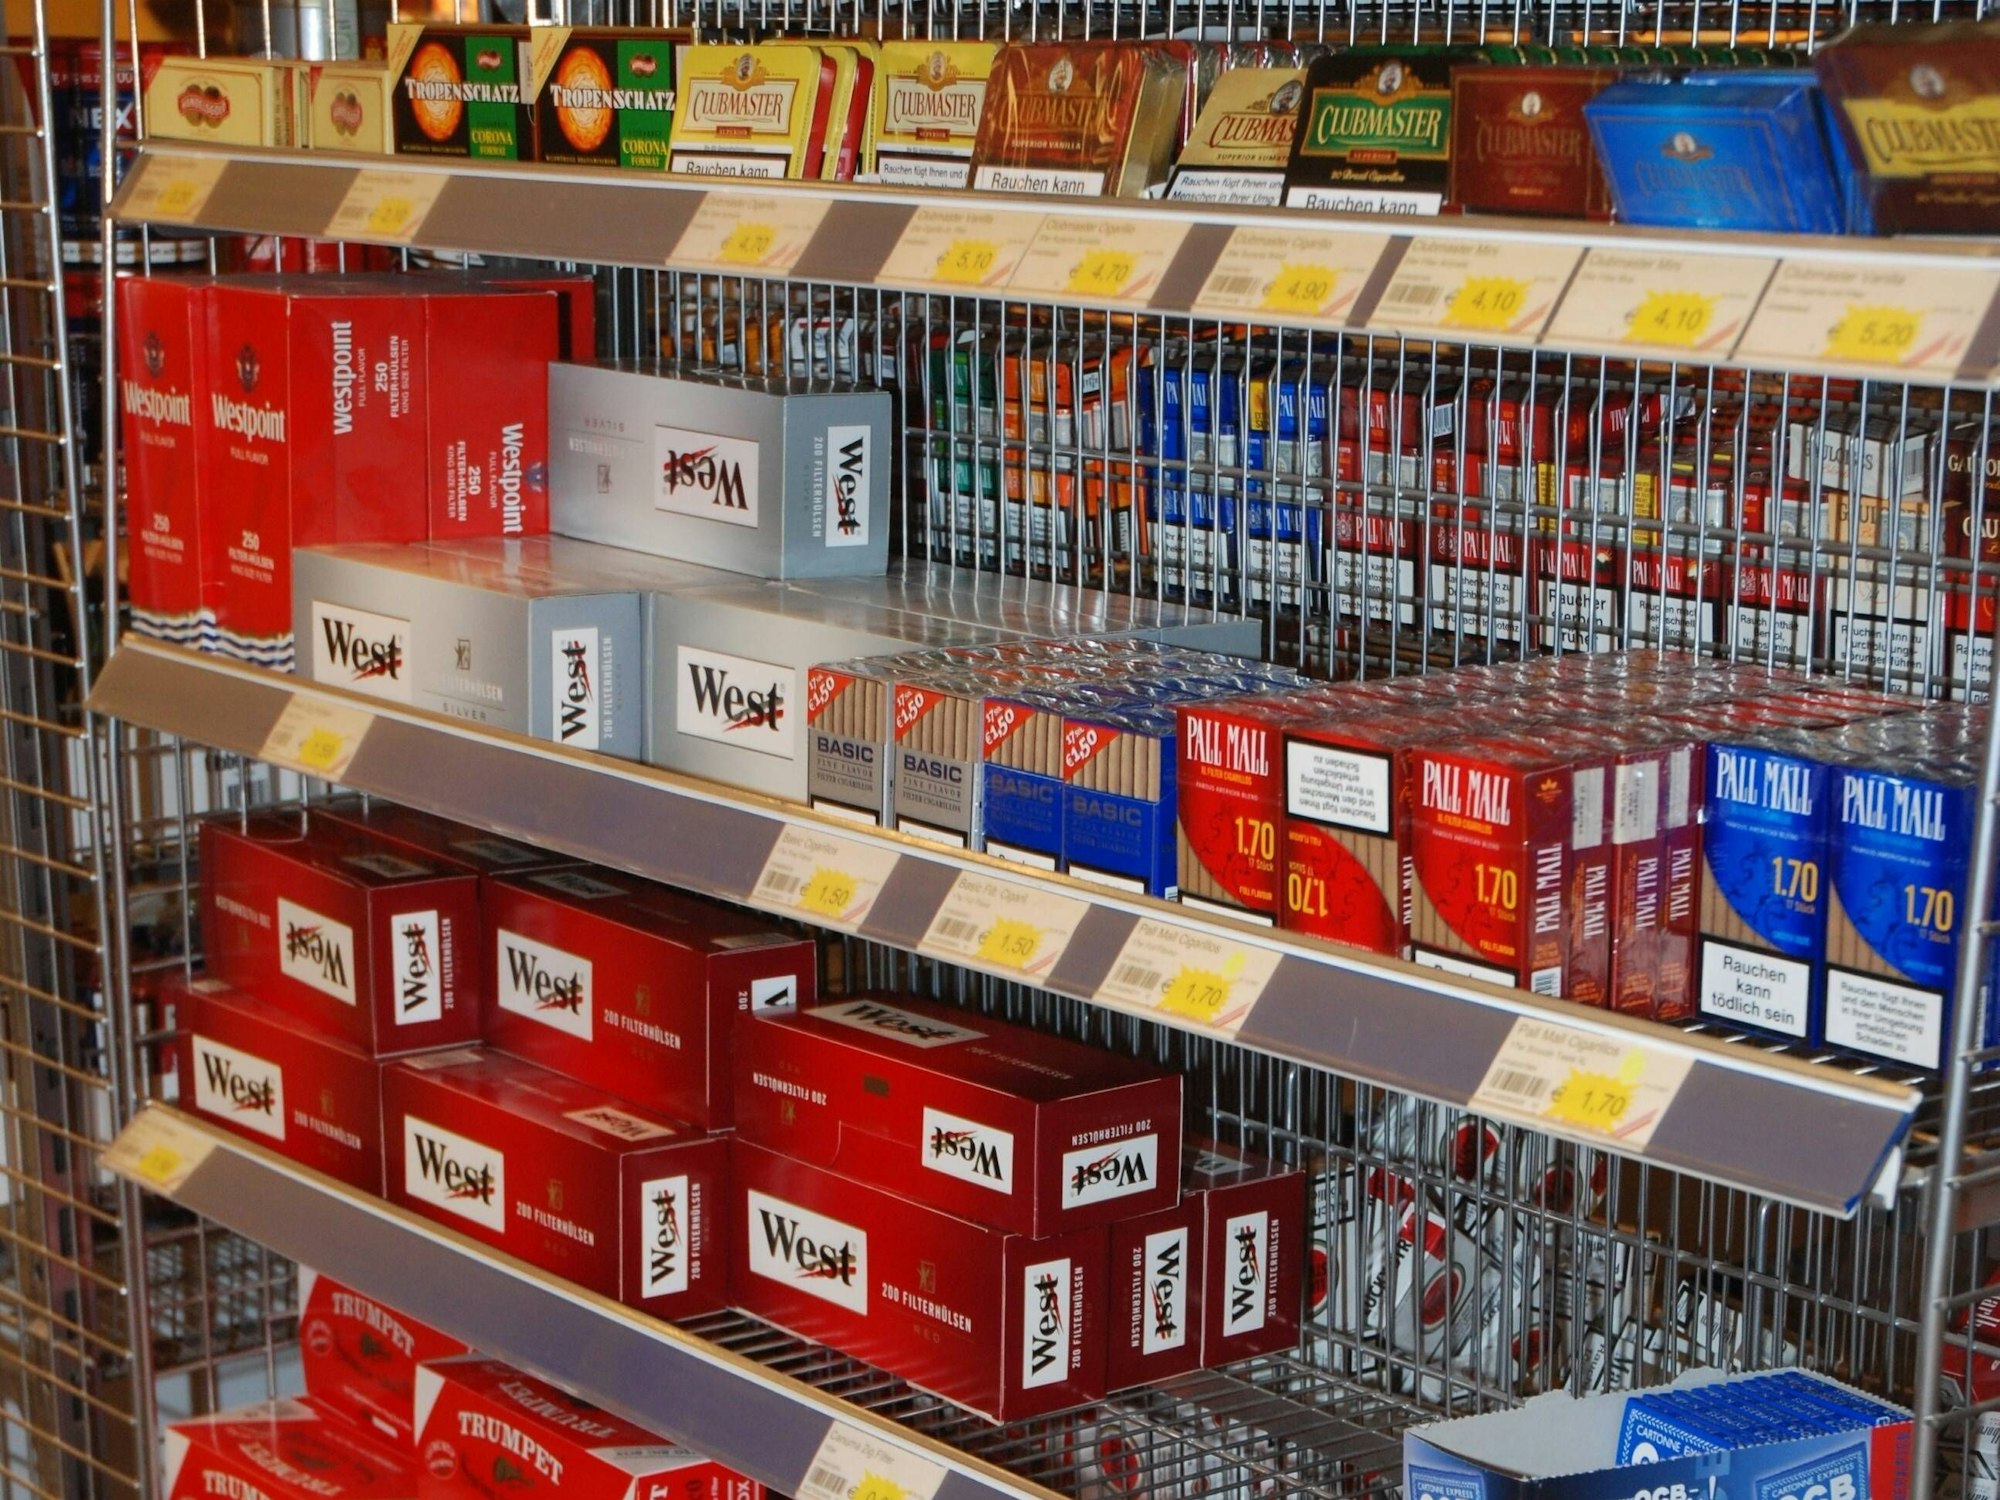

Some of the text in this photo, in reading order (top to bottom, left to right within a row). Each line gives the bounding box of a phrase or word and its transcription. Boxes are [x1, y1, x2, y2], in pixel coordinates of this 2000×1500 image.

[405, 78, 519, 104] TROPENSCHATZ
[551, 84, 676, 111] TROPENSCHATZ
[693, 89, 784, 122] CLUBMASTER
[893, 89, 976, 125] CLUBMASTER
[472, 130, 513, 145] CORONA
[622, 139, 669, 155] CORONA
[1011, 139, 1081, 150] SUPERIOR VANILLA
[1317, 105, 1442, 147] CLUBMASTER
[631, 156, 659, 167] FORMAT
[687, 161, 768, 178] Rauchen kann
[885, 163, 962, 179] Rauchen fügt Ihnen und
[991, 172, 1085, 194] Rauchen kann
[1181, 177, 1266, 187] Rauchen Ihnen
[1306, 194, 1417, 215] Rauchen kann
[1092, 263, 1129, 281] 4,70
[1287, 282, 1328, 301] 4,90
[1472, 291, 1516, 313] 4,10
[1654, 308, 1704, 330] 4,10
[1860, 320, 1914, 346] 5,20
[331, 320, 356, 435] Westpoint
[358, 348, 366, 407] FULL FLAVOR
[375, 363, 388, 392] 250
[124, 381, 191, 427] Westpoint
[212, 393, 285, 442] Westpoint
[468, 466, 481, 495] 250
[498, 423, 527, 533] Westpoint
[665, 447, 749, 511] West
[813, 436, 823, 538] 200 FILTERHÜLSEN
[832, 435, 865, 537] West
[242, 530, 260, 551] 250
[321, 617, 402, 681] West
[561, 640, 594, 741] West
[603, 637, 613, 739] 200 FILTERHÜLSEN
[688, 663, 784, 732] West
[443, 702, 487, 722] SILVER
[817, 736, 873, 763] BASIC
[1186, 715, 1268, 776] PALL MALL
[817, 759, 873, 779] FINE FLAVOR
[904, 754, 962, 783] BASIC
[991, 774, 1053, 803] BASIC
[1716, 751, 1812, 816] PALL MALL
[929, 783, 961, 798] FLAVOR
[1073, 795, 1142, 827] BASIC
[1422, 760, 1510, 825] PALL MALL
[1842, 775, 1945, 842] PALL MALL
[1235, 816, 1275, 860] 1.70
[1256, 859, 1274, 871] Stück
[1475, 863, 1517, 909] 1.70
[1536, 842, 1563, 889] MALL
[1670, 848, 1692, 921] PALL MALL
[1772, 855, 1819, 903] 1.70
[818, 885, 850, 907] 1,50
[1288, 873, 1328, 917] 1.70
[1535, 890, 1561, 934] PALL
[1583, 865, 1607, 939] PALL MALL
[1635, 857, 1658, 930] PALL MALL
[1904, 884, 1954, 932] 1.70
[286, 922, 348, 989] West
[1001, 934, 1035, 956] 1,50
[402, 922, 432, 1014] West
[507, 946, 583, 1016] West
[1723, 955, 1787, 984] Rauchen
[738, 990, 748, 1011] 200
[1187, 983, 1223, 1007] 1,70
[1712, 992, 1795, 1026] tödlich sein
[1736, 980, 1772, 1000] kann
[604, 1008, 681, 1049] 200 FILTERHÜLSEN
[843, 1002, 958, 1040] West
[203, 1051, 274, 1116] West
[753, 1072, 827, 1106] FILTERHÜLSEN 200
[1582, 1090, 1626, 1117] 1,70
[931, 1126, 1004, 1181] West
[1071, 1118, 1152, 1146] FILTERHÜLSEN 200
[414, 1133, 494, 1206] West
[1071, 1150, 1149, 1203] West
[516, 1200, 595, 1247] 200 FILTERHÜLSEN
[651, 1189, 682, 1286] West
[691, 1182, 701, 1280] 200 FILTERHÜLSEN
[758, 1208, 857, 1287] West
[1268, 1219, 1279, 1317] 200 FILTERHÜLSEN
[1151, 1239, 1181, 1340] West
[1231, 1224, 1261, 1325] West
[882, 1282, 972, 1333] 200 FILTERHÜLSEN
[1072, 1266, 1083, 1369] 200 FILTERHÜLSEN
[1131, 1247, 1141, 1348] 200 FILTERHÜLSEN
[331, 1291, 415, 1358] TRUMPET
[1032, 1273, 1063, 1377] West
[458, 1410, 564, 1486] TRUMPET
[1637, 1425, 1681, 1453] CARTONNE
[1446, 1487, 1473, 1499] EXPRESS
[1772, 1478, 1814, 1498] CARTONNE
[1816, 1462, 1855, 1482] EXPRESS
